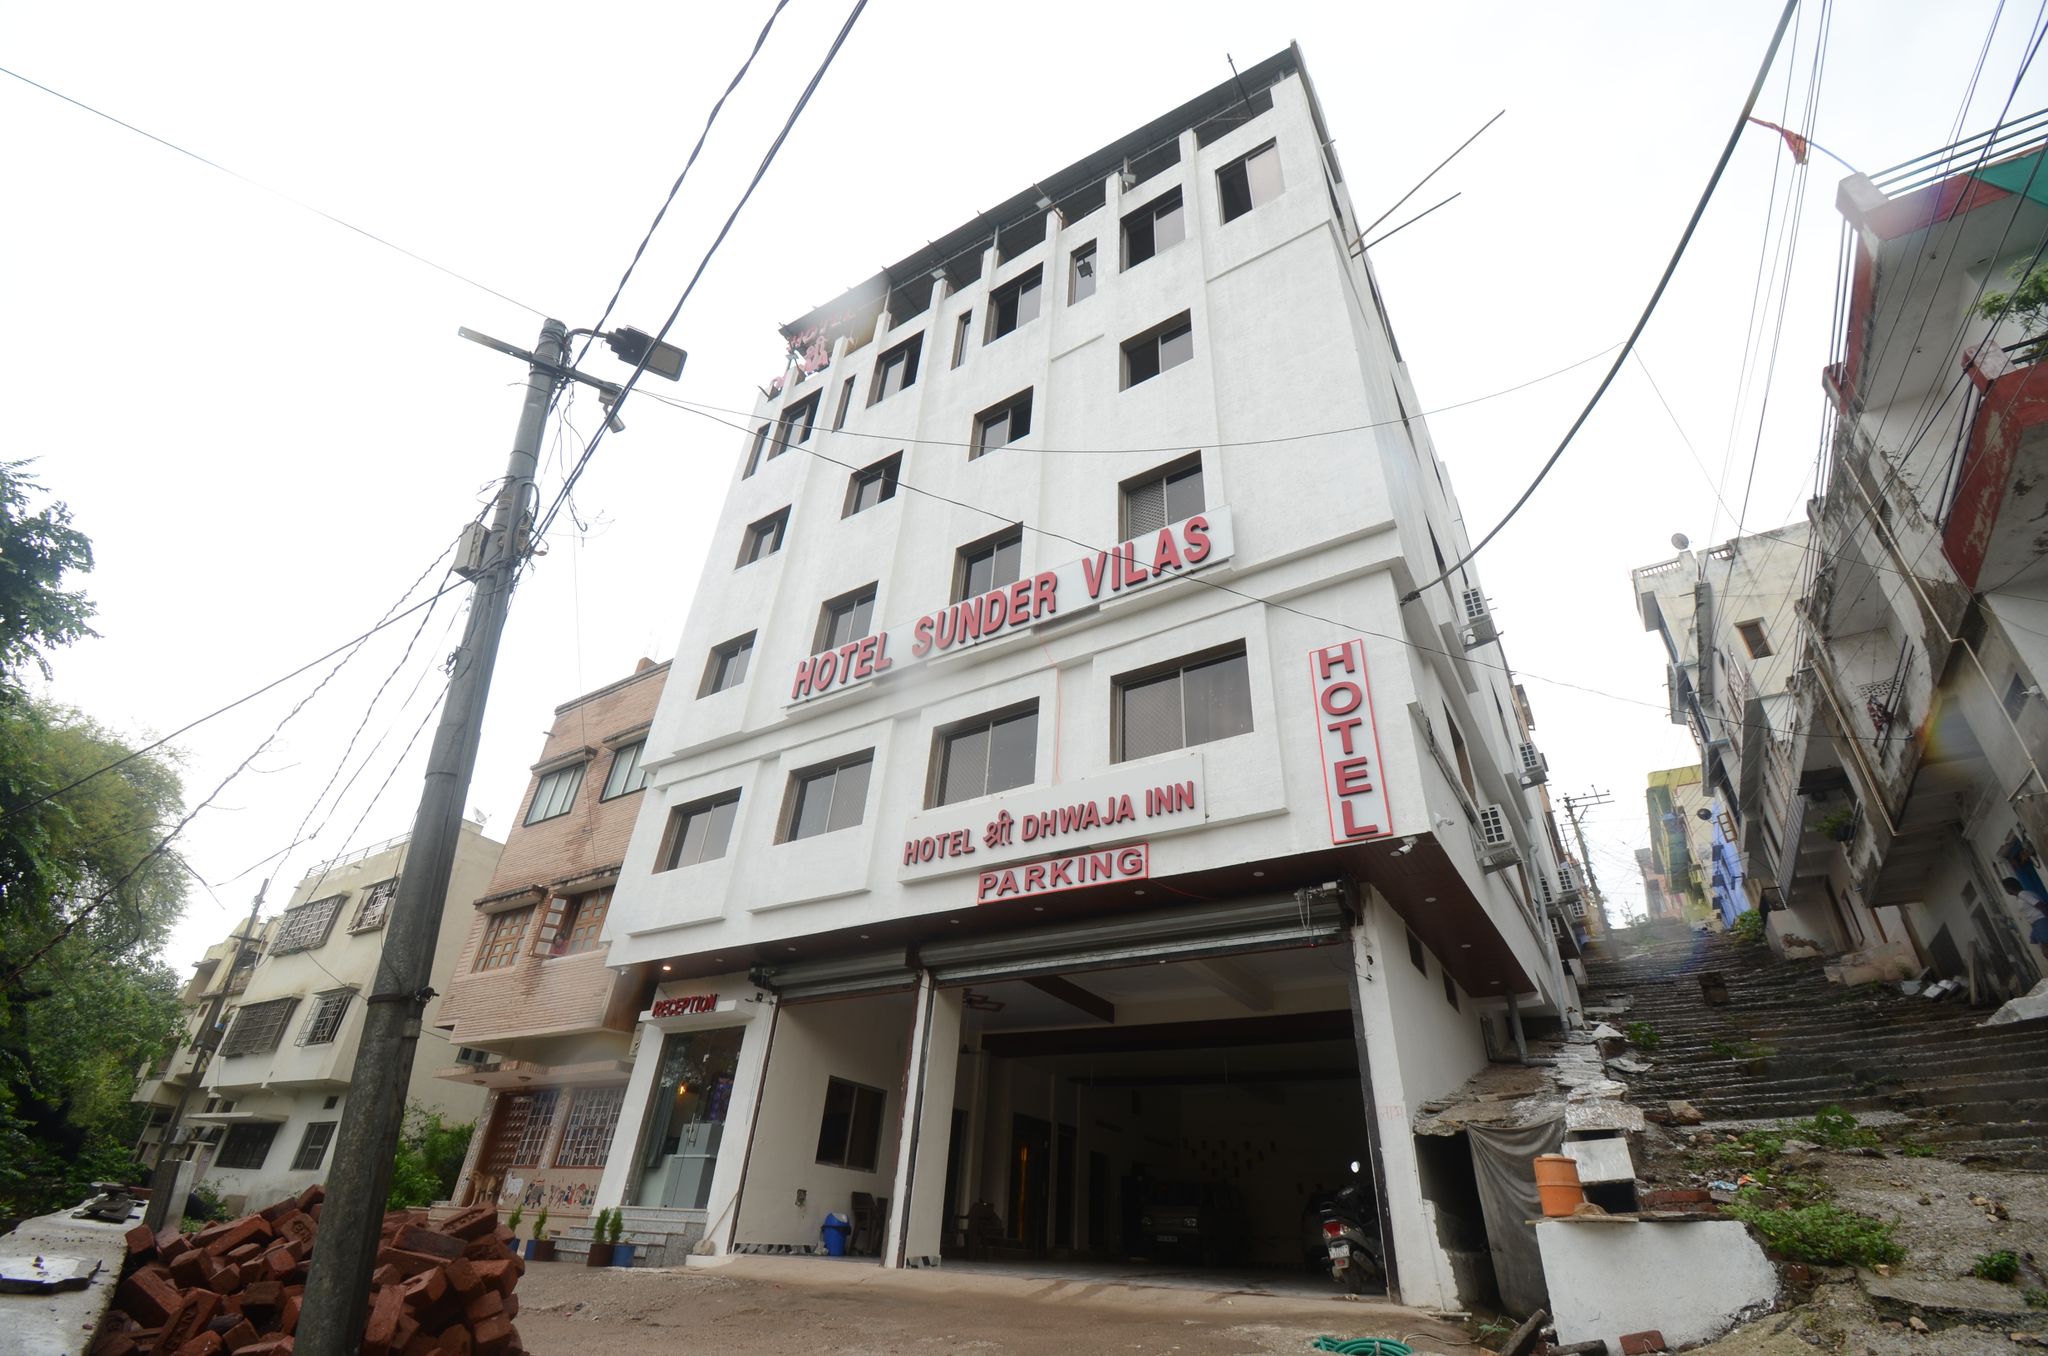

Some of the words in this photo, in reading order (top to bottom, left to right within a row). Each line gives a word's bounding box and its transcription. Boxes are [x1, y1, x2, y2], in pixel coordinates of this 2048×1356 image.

[791, 631, 893, 699] HOTEL
[911, 571, 1058, 657] SUNDER
[1081, 515, 1212, 599] VILAS
[1318, 641, 1379, 837] HOTEL
[903, 828, 976, 866] HOTEL
[982, 809, 1014, 848] श्री
[1021, 794, 1136, 842] DHWAJA
[1145, 780, 1195, 817] INN
[979, 848, 1145, 899] PARKING
[652, 994, 718, 1018] RECEPTION
